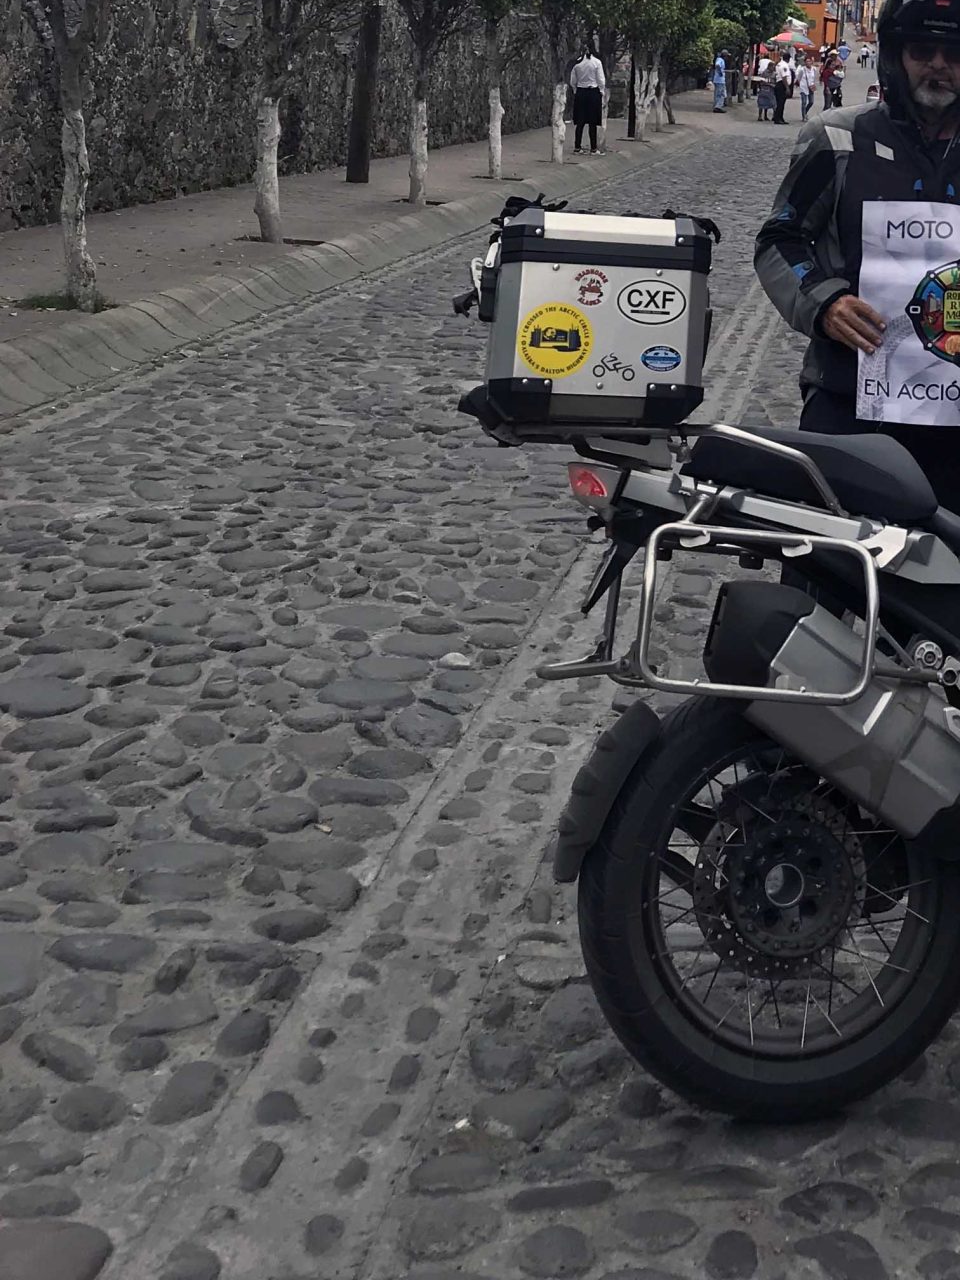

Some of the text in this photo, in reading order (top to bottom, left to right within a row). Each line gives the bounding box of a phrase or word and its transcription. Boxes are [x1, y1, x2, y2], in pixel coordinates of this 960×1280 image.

[887, 220, 953, 239] MOTO
[627, 289, 676, 309] CXF
[909, 306, 920, 314] O
[523, 310, 543, 333] CROSSED
[559, 306, 580, 319] ARCTIC
[579, 319, 589, 338] CIRCLE
[540, 367, 565, 375] DALTON
[566, 348, 588, 371] HIGHWAY
[864, 379, 890, 397] EN
